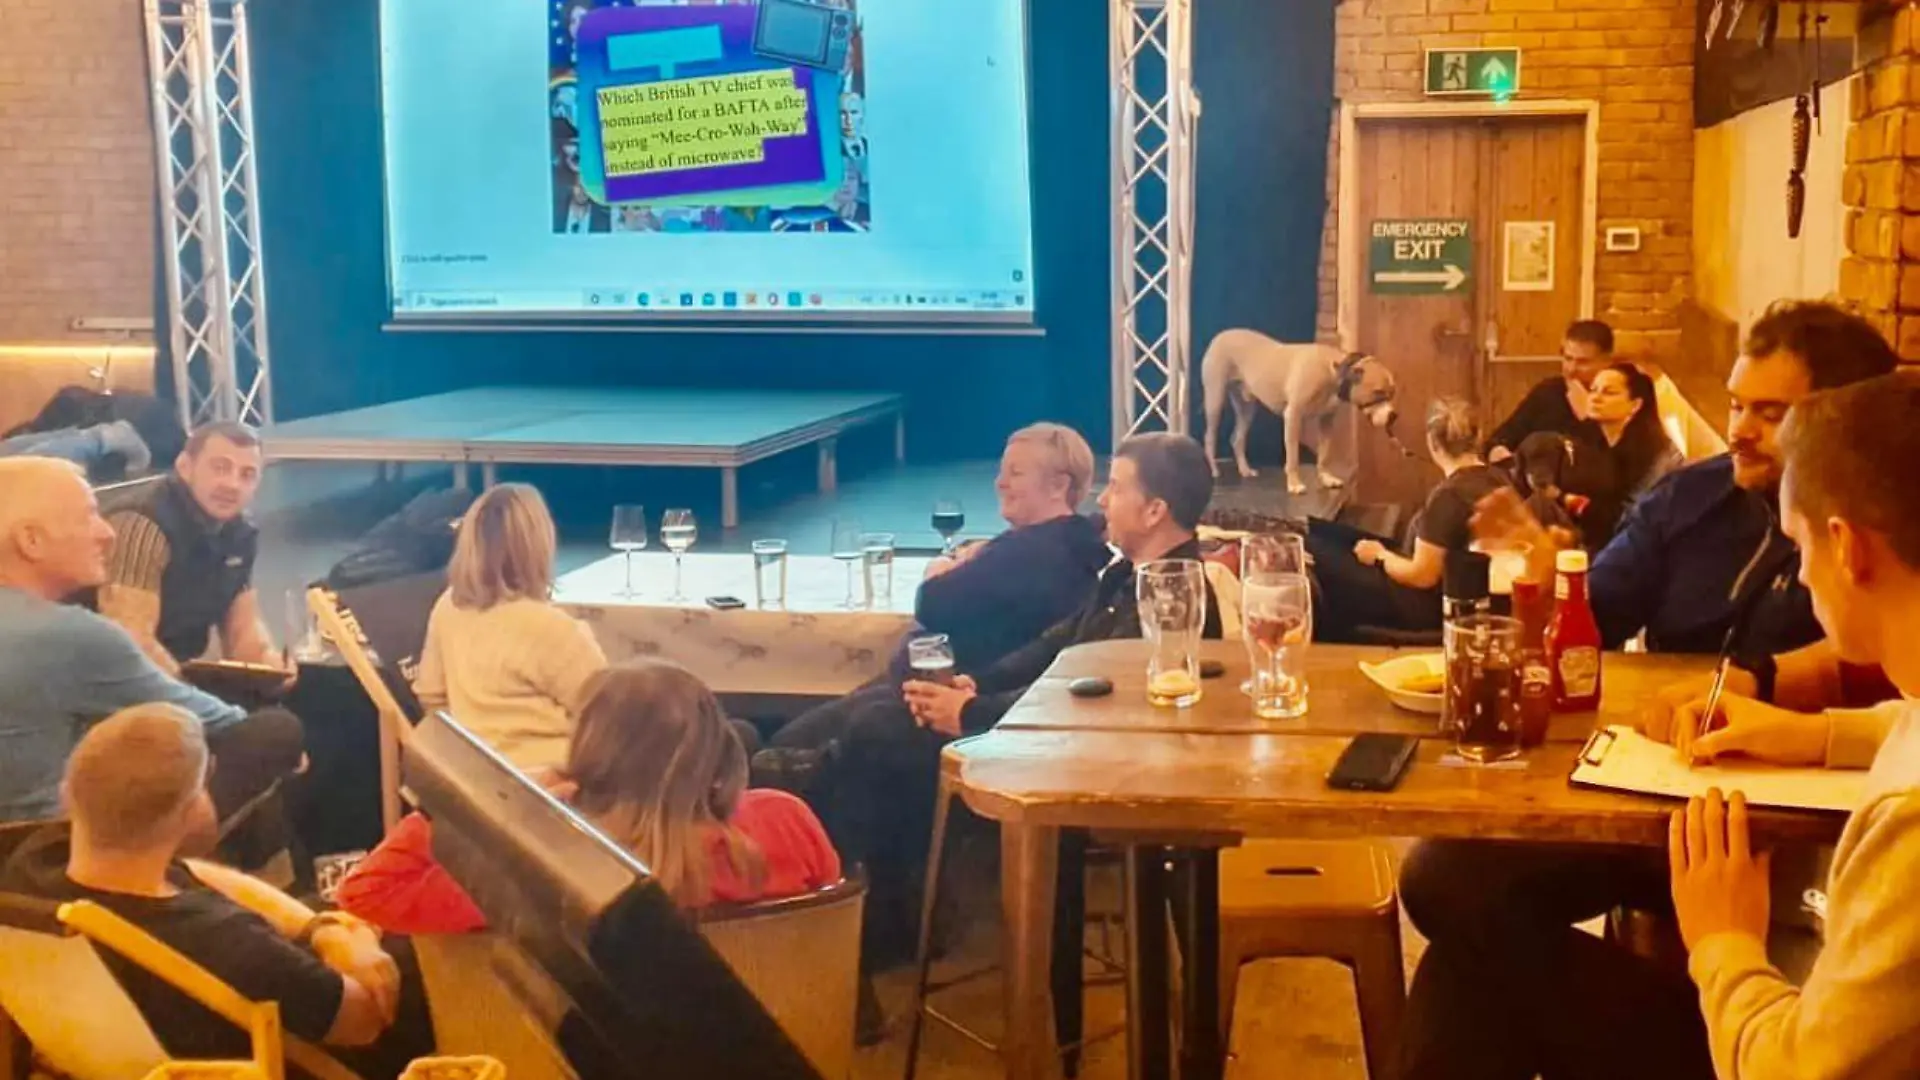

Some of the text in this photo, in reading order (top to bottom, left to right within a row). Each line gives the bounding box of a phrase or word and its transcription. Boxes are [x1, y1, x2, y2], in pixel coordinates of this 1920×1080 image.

[599, 89, 644, 106] Which
[648, 80, 695, 102] British
[699, 80, 721, 95] TV
[727, 75, 764, 93] chief
[678, 105, 697, 121] for
[702, 109, 711, 118] a
[715, 98, 770, 118] BAFTA
[774, 95, 807, 110] after
[659, 153, 673, 168] of
[1373, 221, 1468, 237] EMERGENCY
[1394, 239, 1446, 260] EXIT
